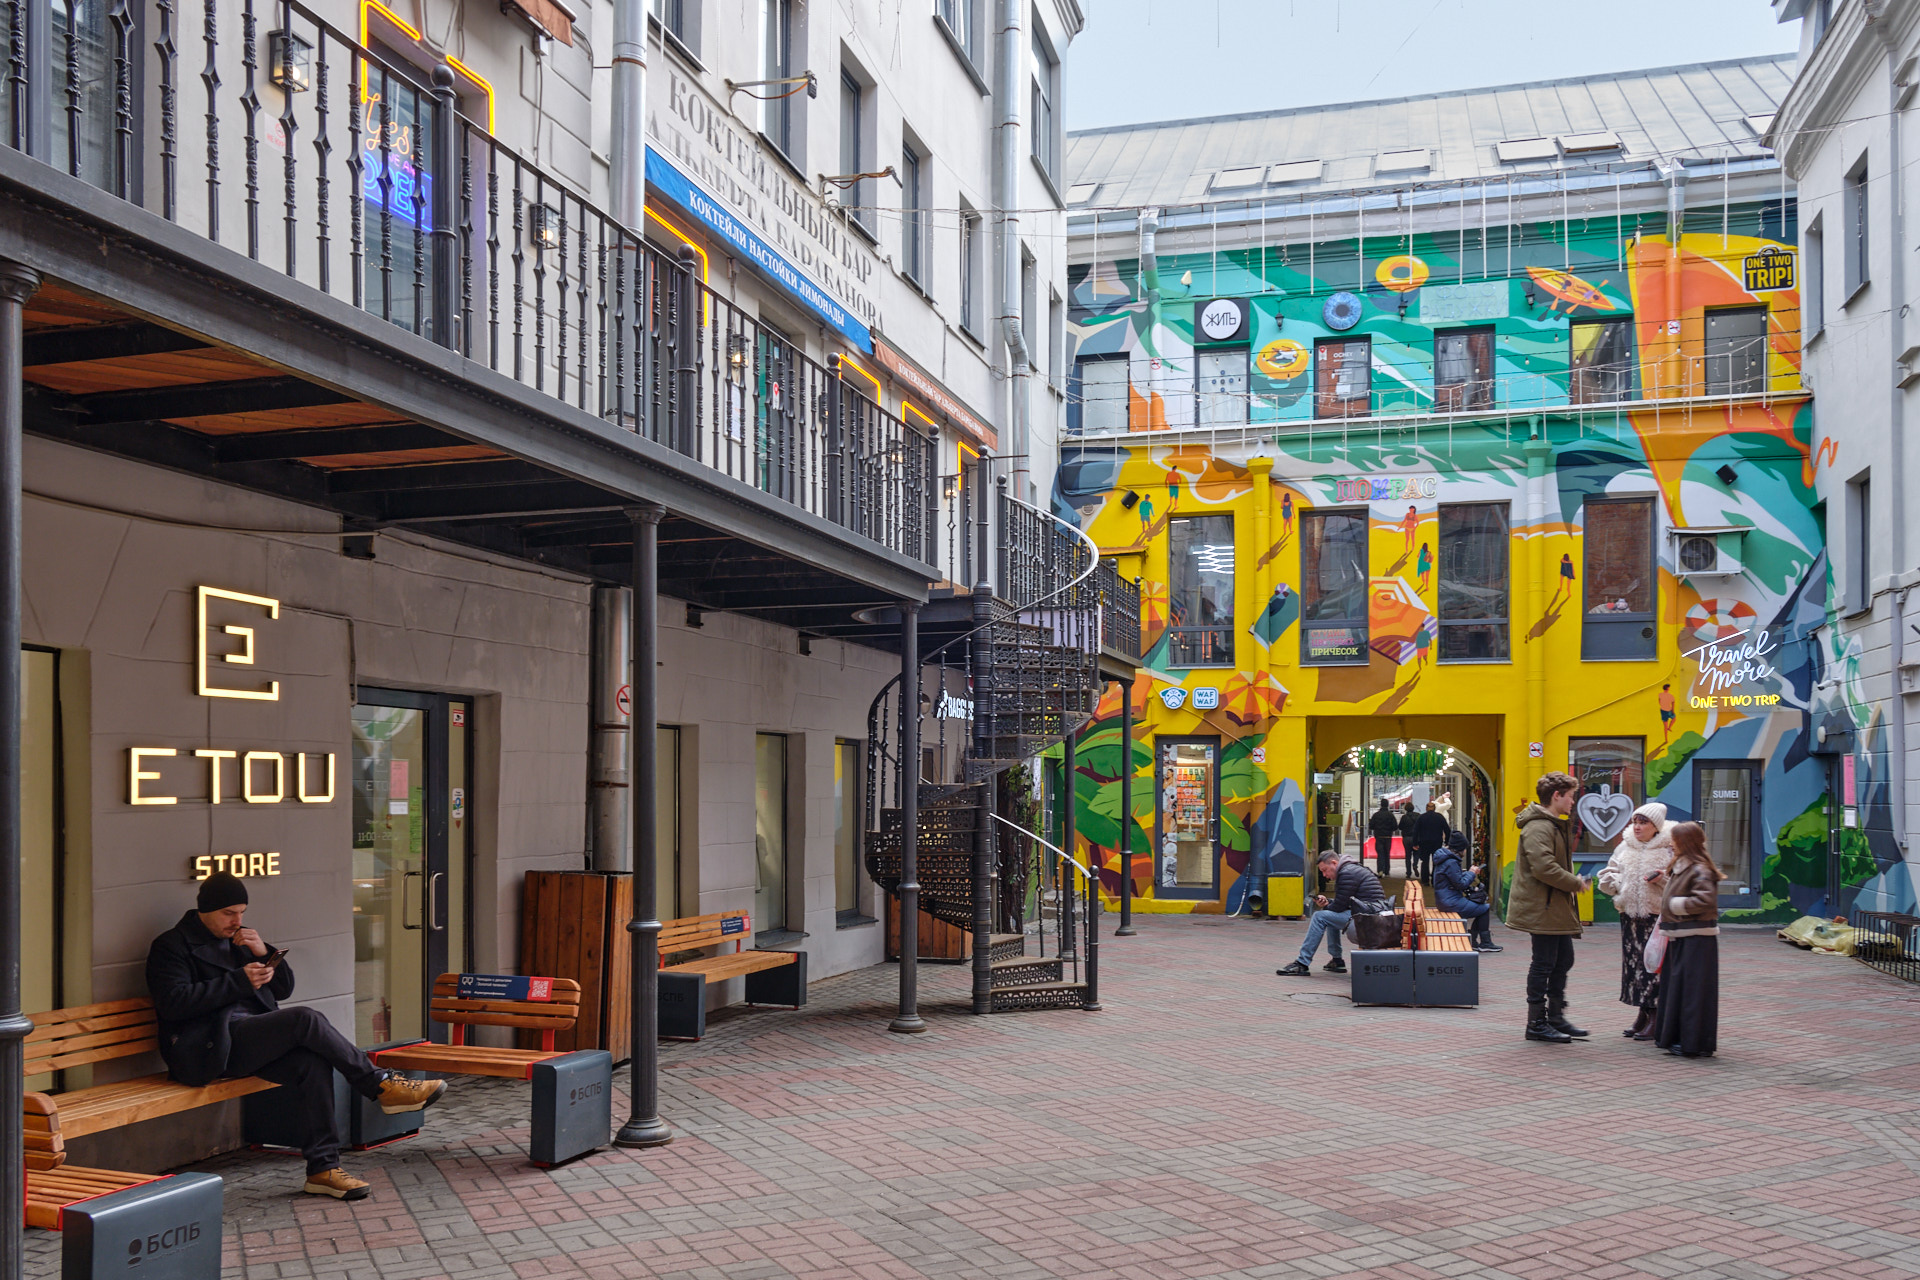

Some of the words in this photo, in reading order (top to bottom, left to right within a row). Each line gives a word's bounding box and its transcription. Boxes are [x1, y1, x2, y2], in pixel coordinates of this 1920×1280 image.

[669, 71, 837, 259] КОКТЕЙЛЬНЫЙ
[842, 235, 872, 285] БАР
[689, 190, 747, 249] КОКТЕЙЛИ
[749, 238, 797, 290] НАСТОЙКИ
[799, 279, 845, 327] ЛИМОНАДЫ
[1746, 257, 1766, 269] ONE
[1768, 254, 1792, 267] TWO
[1746, 266, 1793, 289] TRIP!
[1205, 312, 1237, 327] ЖИТЬ
[1336, 476, 1437, 501] ПОКРАС
[1311, 647, 1359, 656] ПРИЧЕСОК
[1682, 628, 1778, 673] Travel
[1690, 695, 1719, 709] ONE
[1720, 694, 1752, 707] TWO
[1754, 693, 1781, 706] TRIP
[131, 747, 336, 805] ETOU
[1712, 790, 1739, 799] SUMEI
[195, 852, 281, 881] STORE
[1372, 965, 1400, 973] БСПБ
[1436, 966, 1464, 974] БСПБ
[578, 1081, 602, 1100] БСПБ
[146, 1221, 200, 1255] БСПБ
